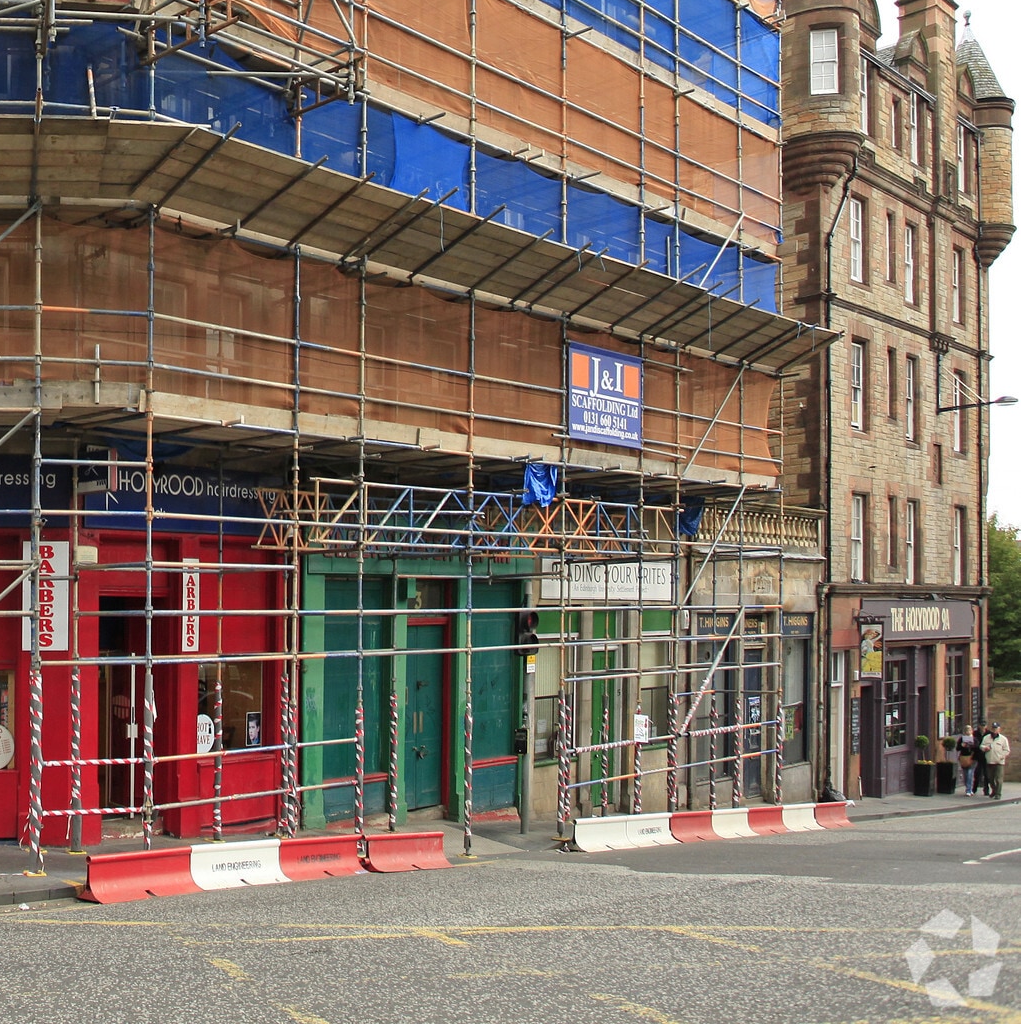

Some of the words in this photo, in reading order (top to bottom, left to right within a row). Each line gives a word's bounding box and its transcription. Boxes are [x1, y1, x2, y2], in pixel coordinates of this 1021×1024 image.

[589, 356, 623, 397] J&I
[571, 394, 626, 417] SCAFFOLDING
[626, 404, 638, 419] Ltd
[571, 422, 639, 441] www.jandiscaffolding.co.uk
[583, 410, 598, 425] 0131
[599, 413, 612, 427] 660
[612, 416, 627, 431] 5141
[38, 545, 56, 648] BARBERS
[414, 591, 423, 609] 3
[890, 607, 904, 632] THE
[905, 606, 940, 632] HOLYROOD
[941, 607, 950, 631] 9A
[227, 859, 262, 872] ENGINEERING
